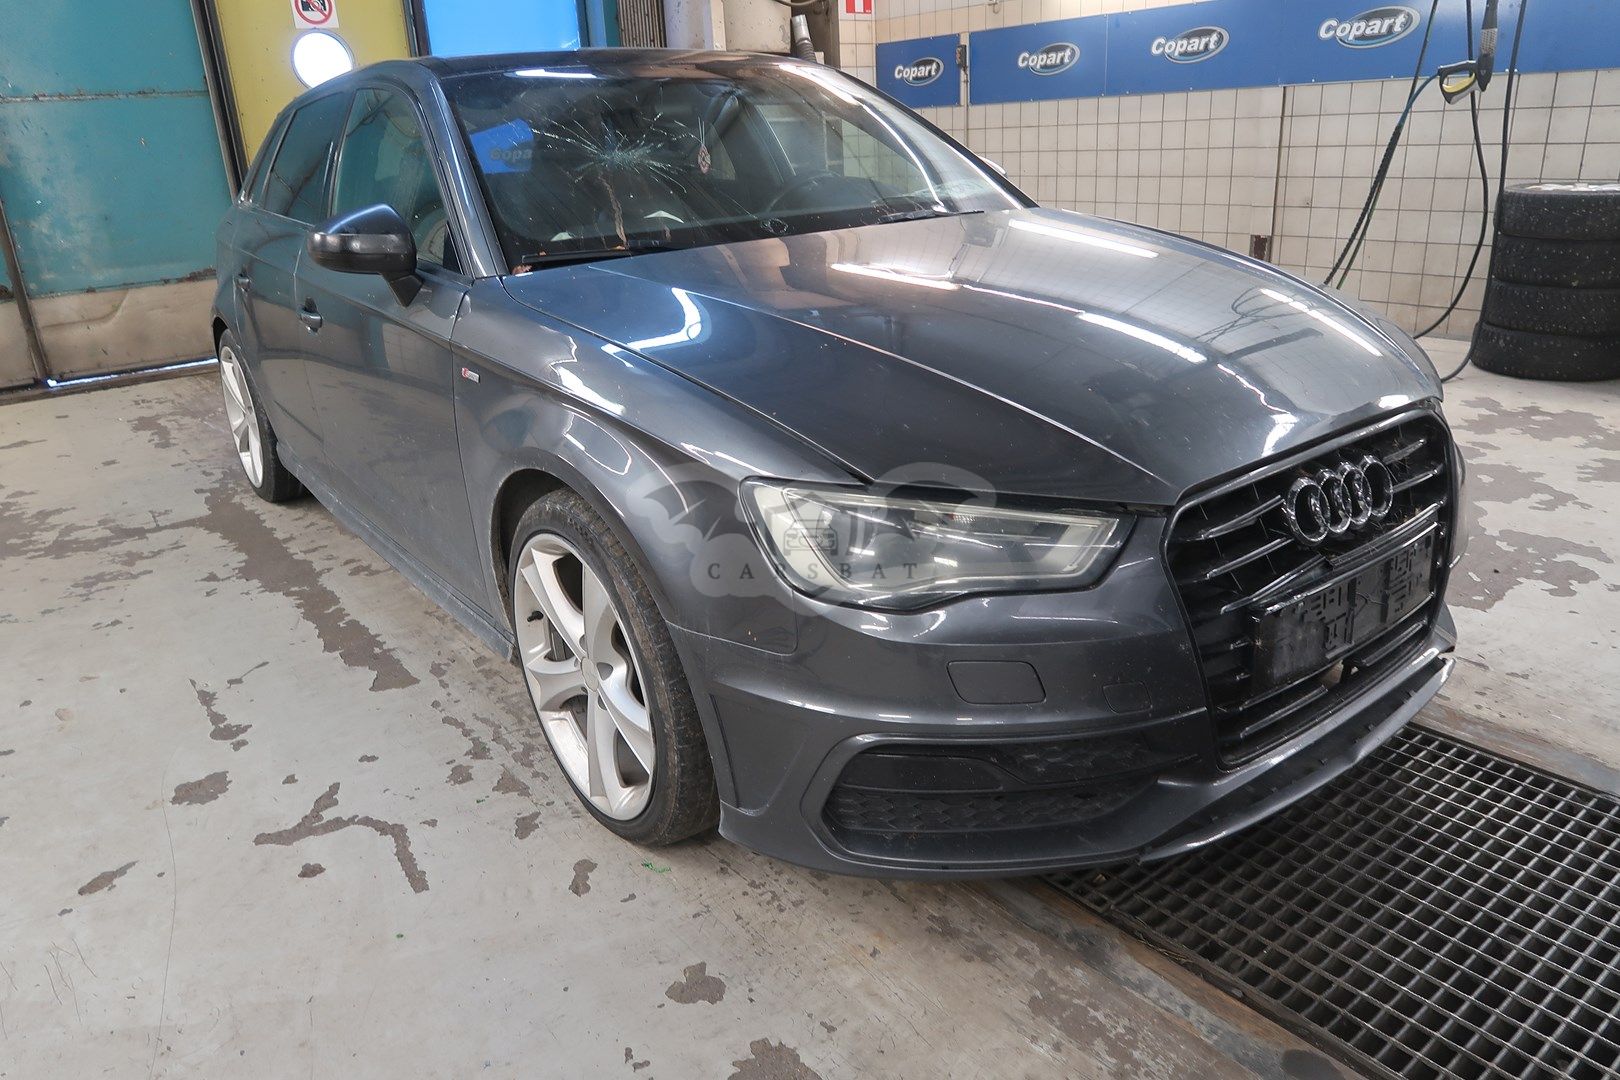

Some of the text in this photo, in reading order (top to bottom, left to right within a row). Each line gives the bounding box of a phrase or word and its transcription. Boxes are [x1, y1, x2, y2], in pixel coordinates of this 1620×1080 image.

[1318, 11, 1407, 41] Copart
[1151, 31, 1219, 57] Copart
[1018, 47, 1072, 70] Copart
[894, 61, 937, 81] Copart
